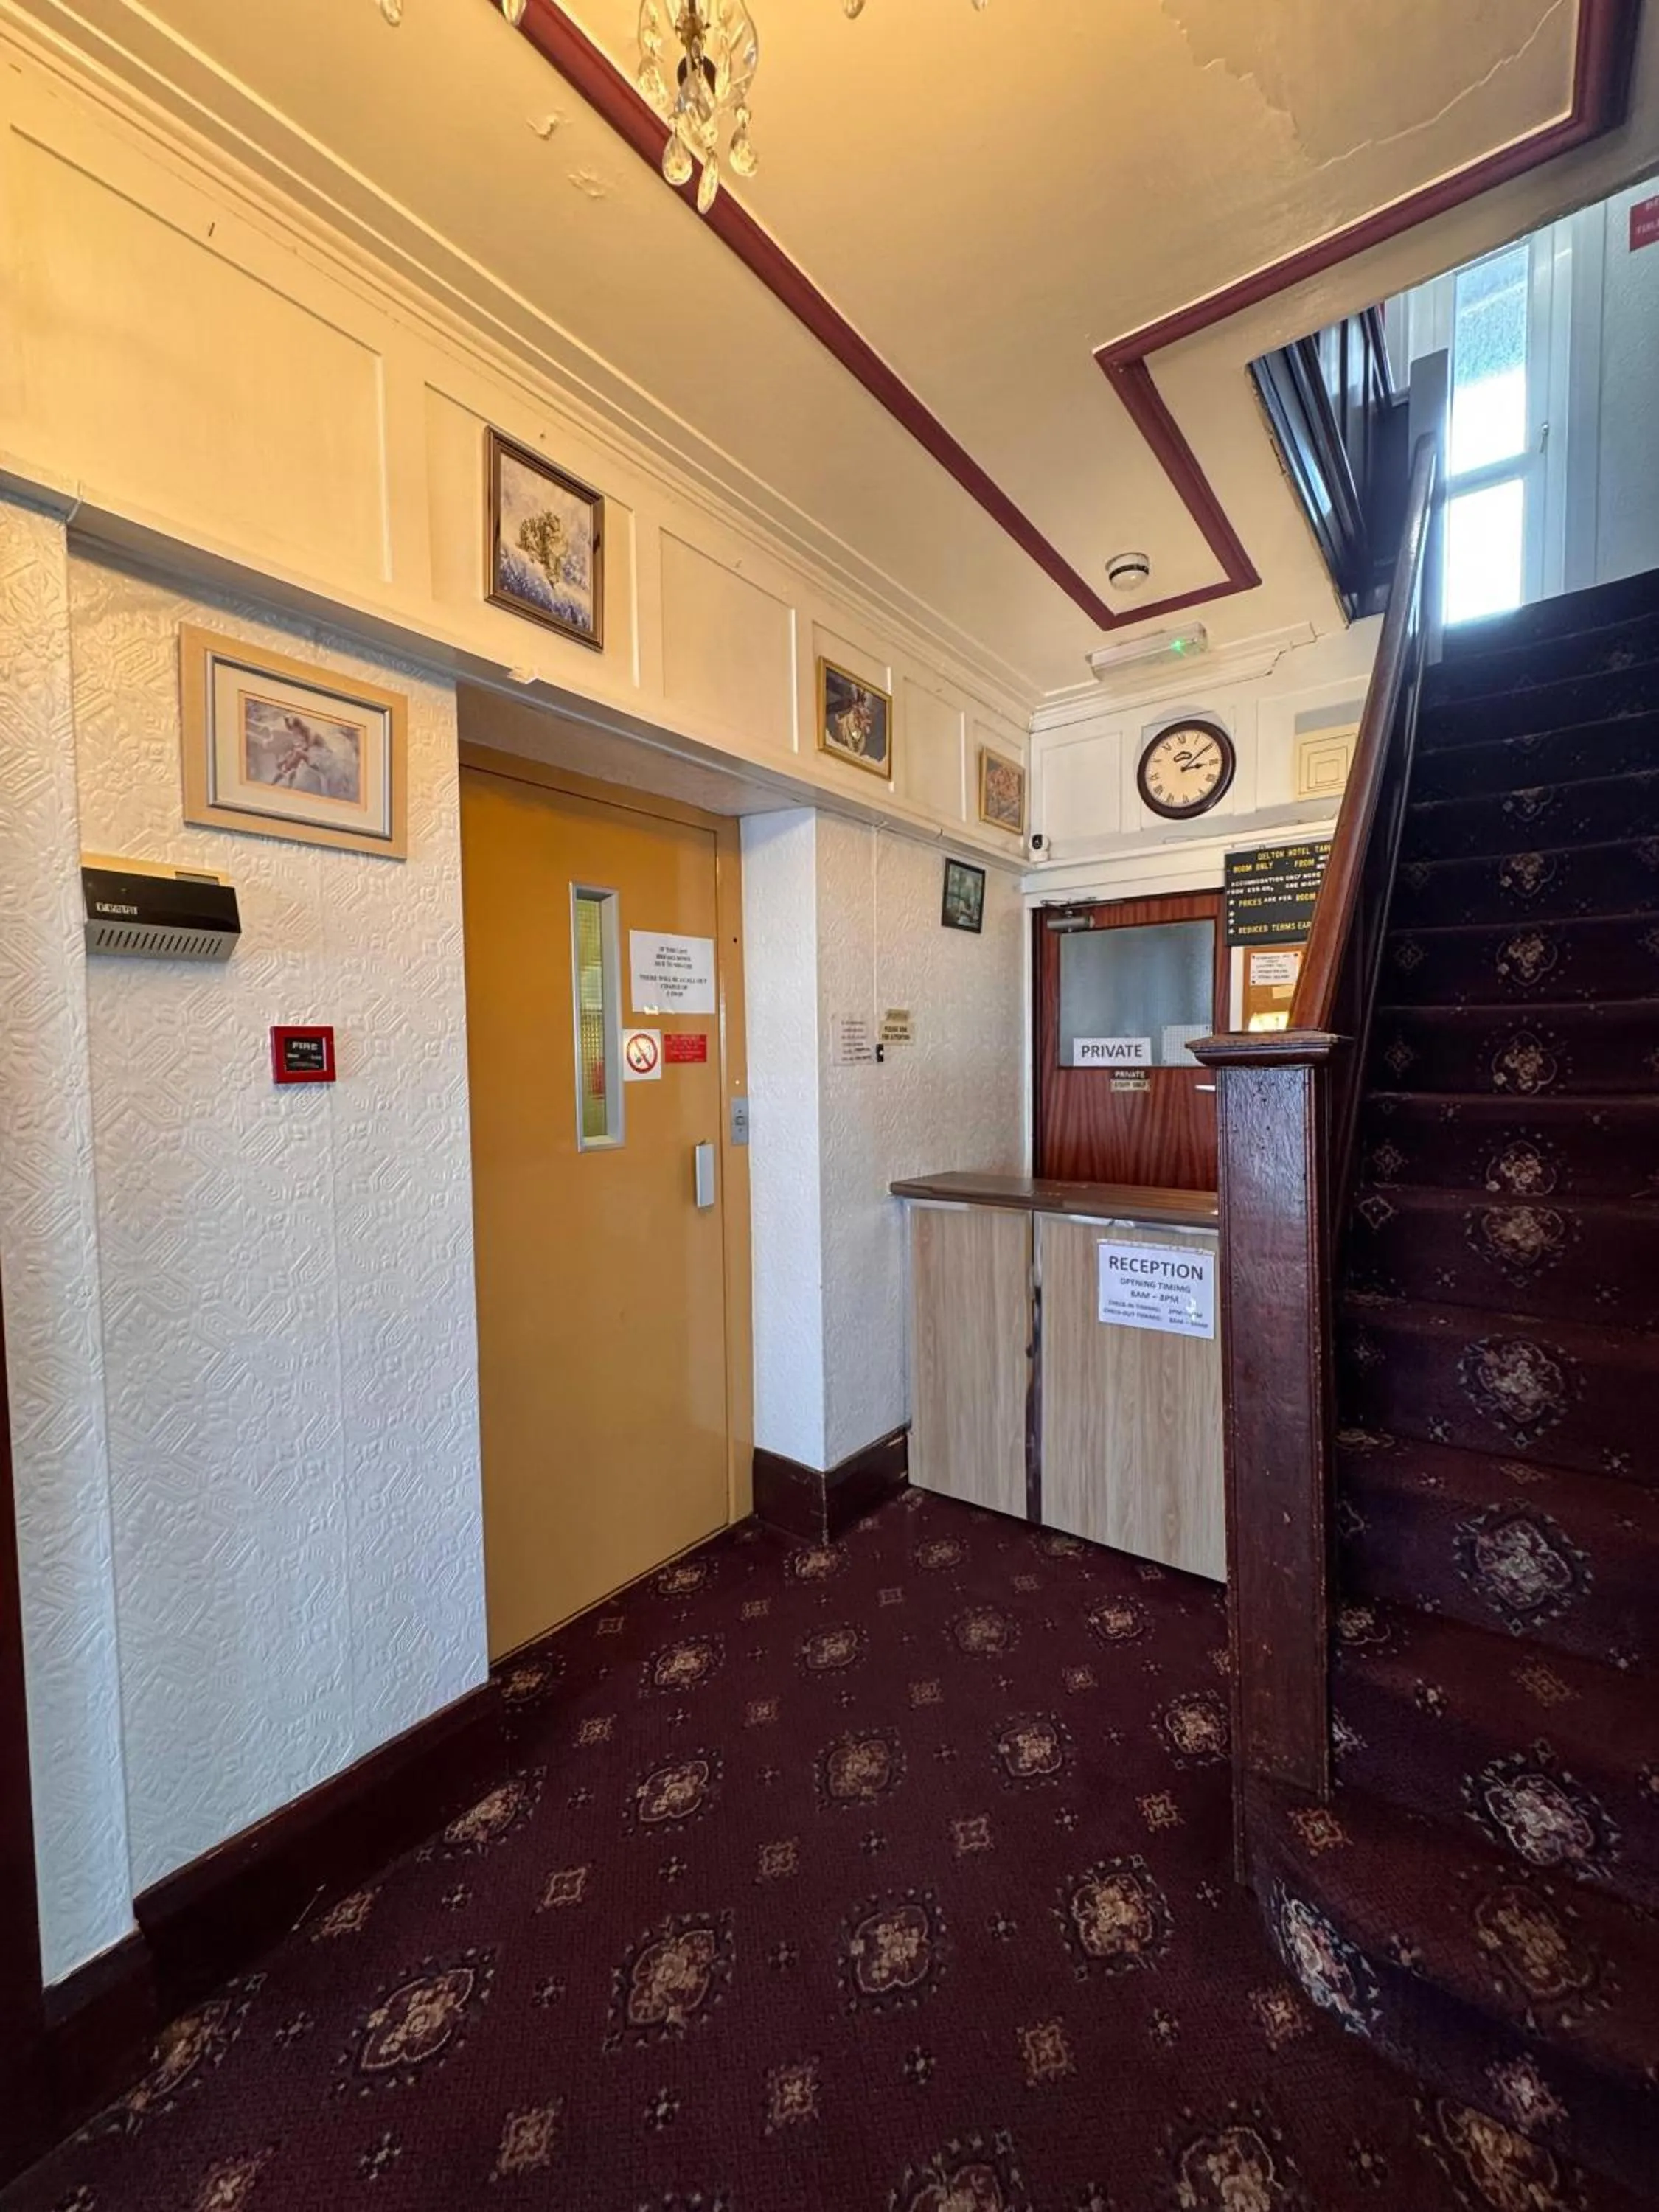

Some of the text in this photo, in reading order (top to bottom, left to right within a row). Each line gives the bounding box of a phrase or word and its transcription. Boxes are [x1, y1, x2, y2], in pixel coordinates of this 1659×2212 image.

[1288, 846, 1310, 856] HOTEL
[1256, 861, 1273, 871] ONLY
[1294, 858, 1315, 868] FROM
[1272, 922, 1295, 931] TERMS
[292, 1040, 319, 1051] FIRE
[1081, 1044, 1143, 1058] PRIVATE
[1114, 1070, 1145, 1079] PRIVATE
[1108, 1256, 1203, 1281] RECEPTION
[1120, 1277, 1192, 1294] OPENING TIMING
